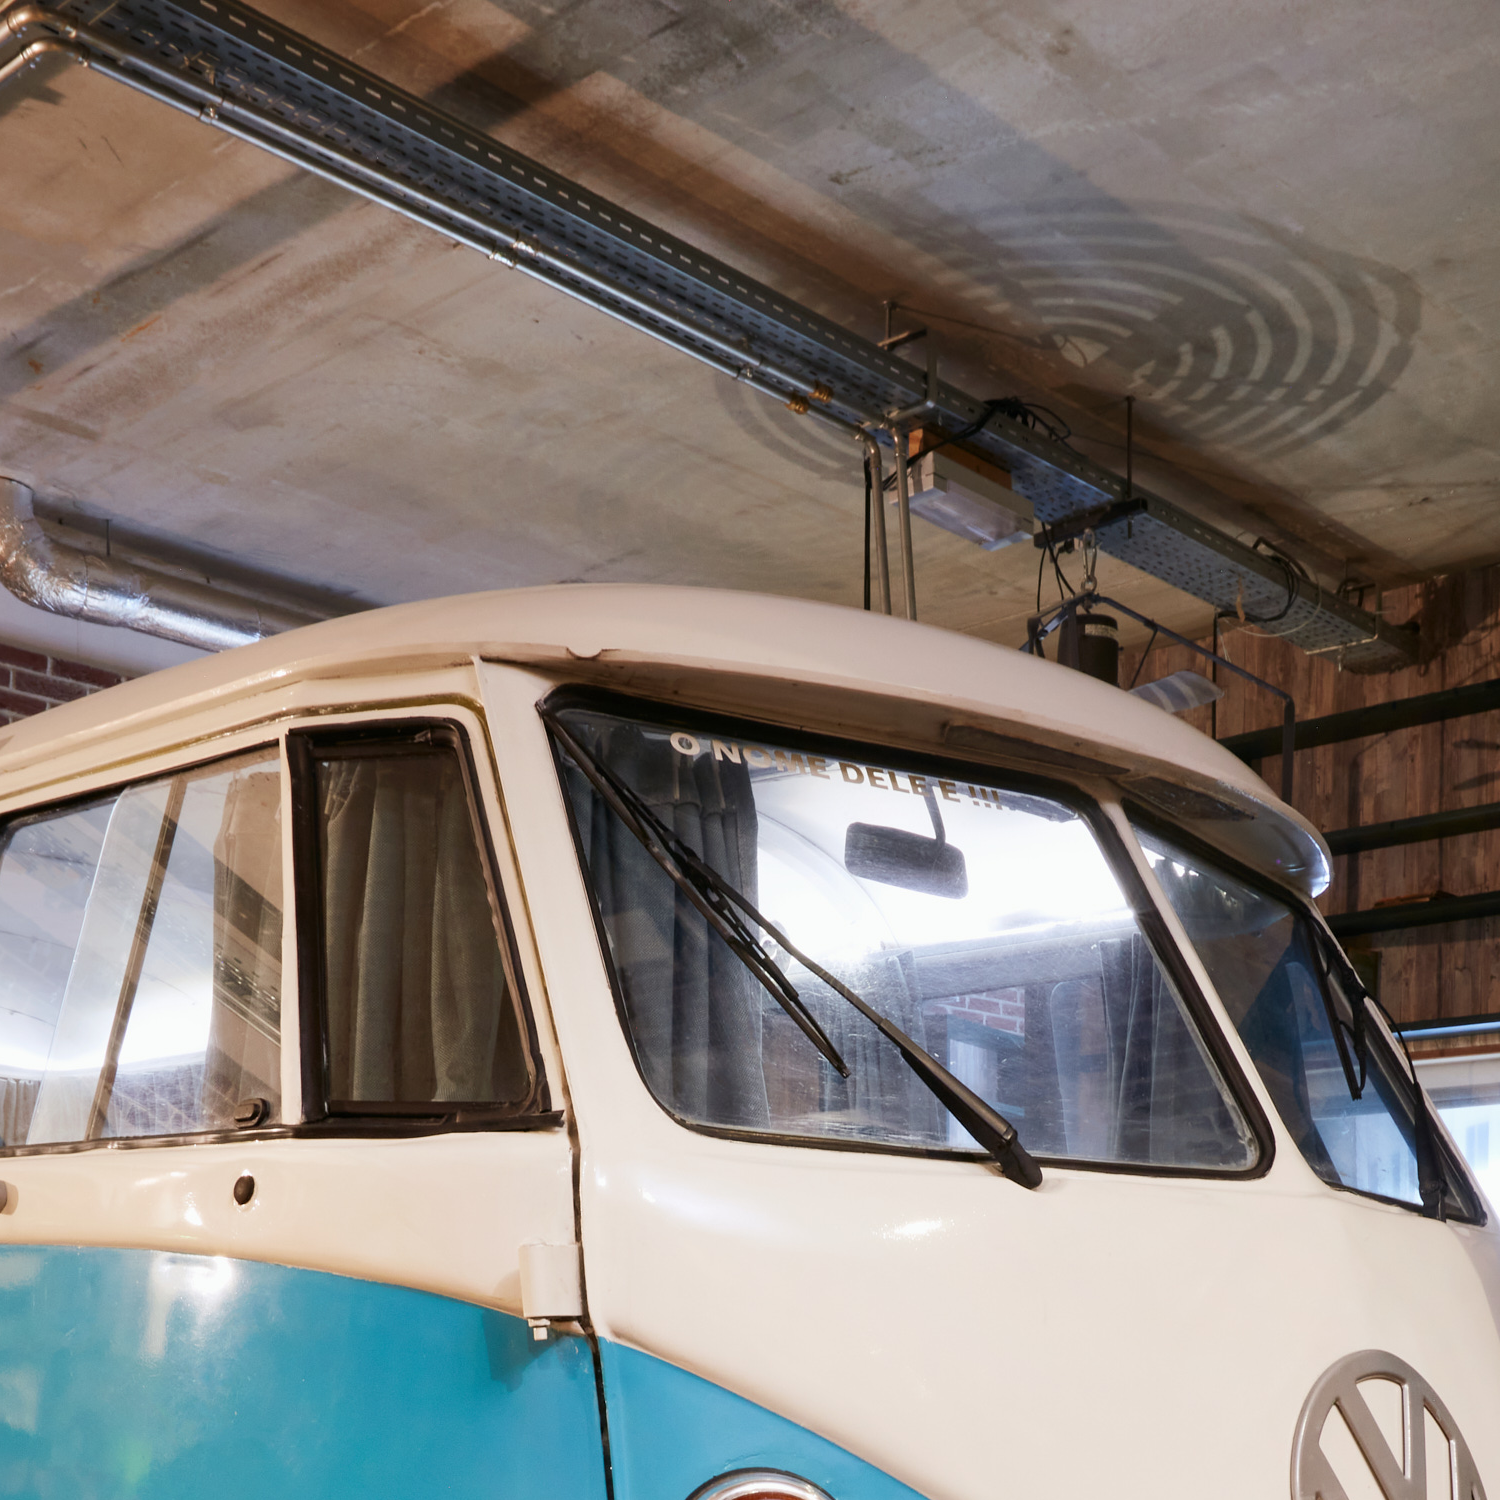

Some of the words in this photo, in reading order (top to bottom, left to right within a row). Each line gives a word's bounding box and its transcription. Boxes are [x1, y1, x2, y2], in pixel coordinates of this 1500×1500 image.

[670, 732, 700, 756] O
[712, 739, 831, 780] NOME
[838, 761, 930, 798] DELE
